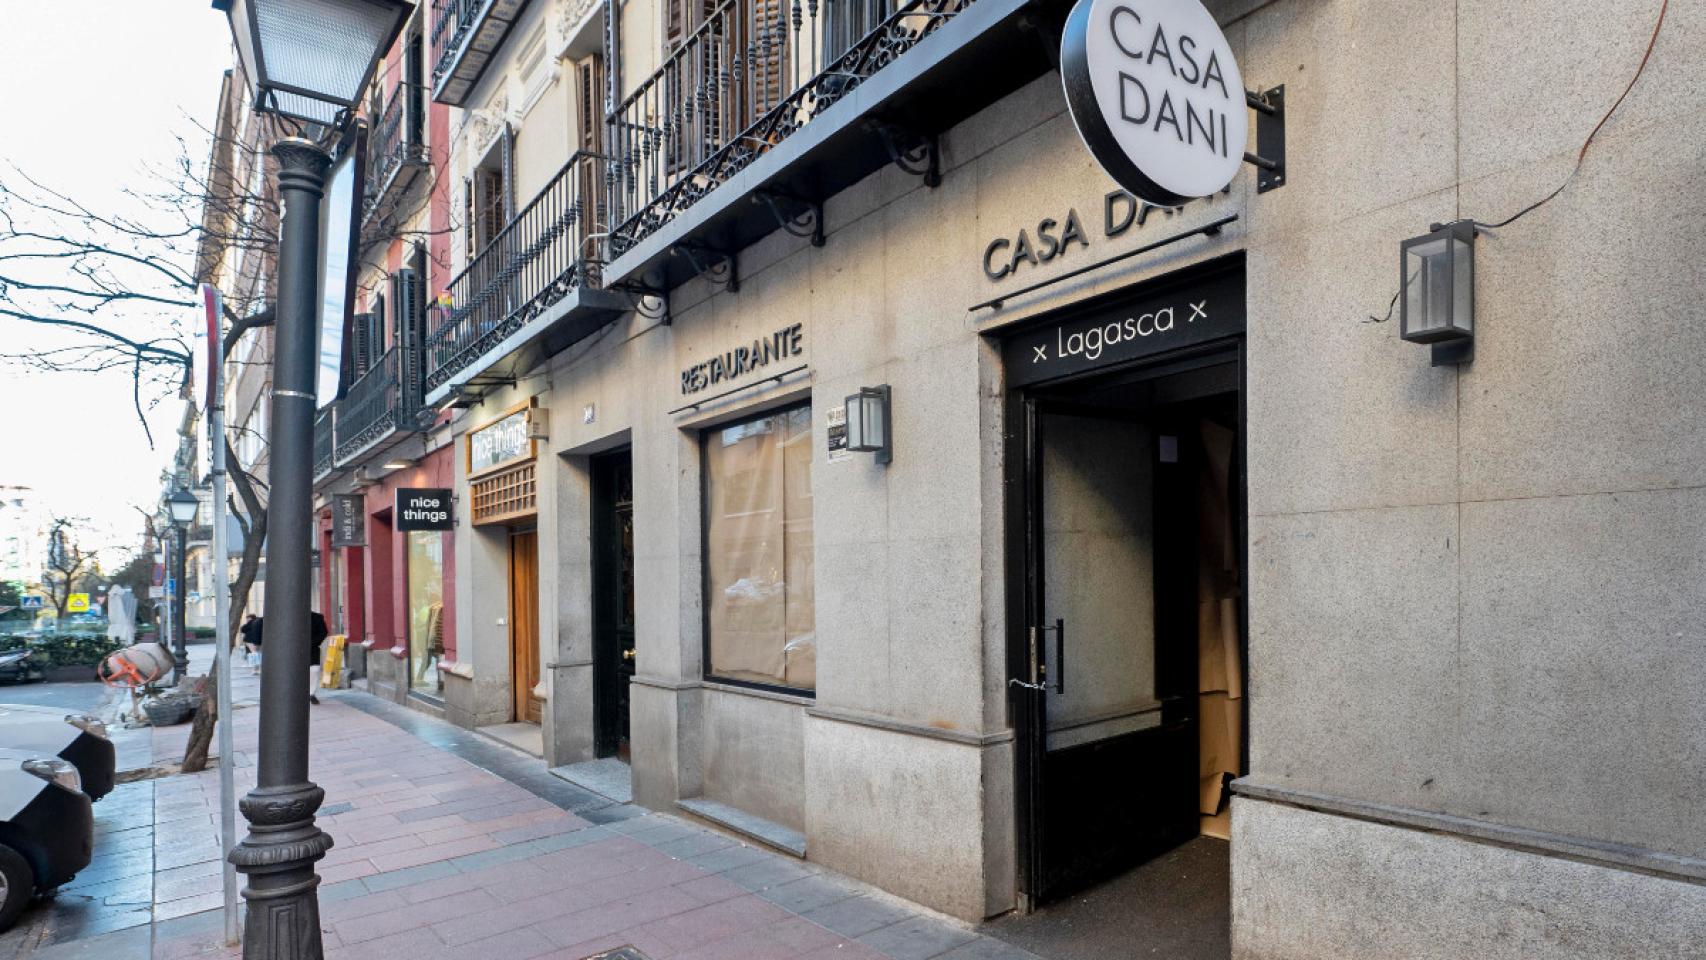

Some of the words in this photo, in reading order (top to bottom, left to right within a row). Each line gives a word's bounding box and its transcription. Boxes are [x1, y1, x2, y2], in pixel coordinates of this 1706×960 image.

[1109, 5, 1229, 99] CASA
[1118, 70, 1228, 159] DANI
[983, 207, 1090, 280] CASA
[681, 322, 803, 396] RESTAURANTE
[1058, 306, 1174, 360] Lagasca
[403, 508, 447, 523] things
[410, 496, 440, 508] nice
